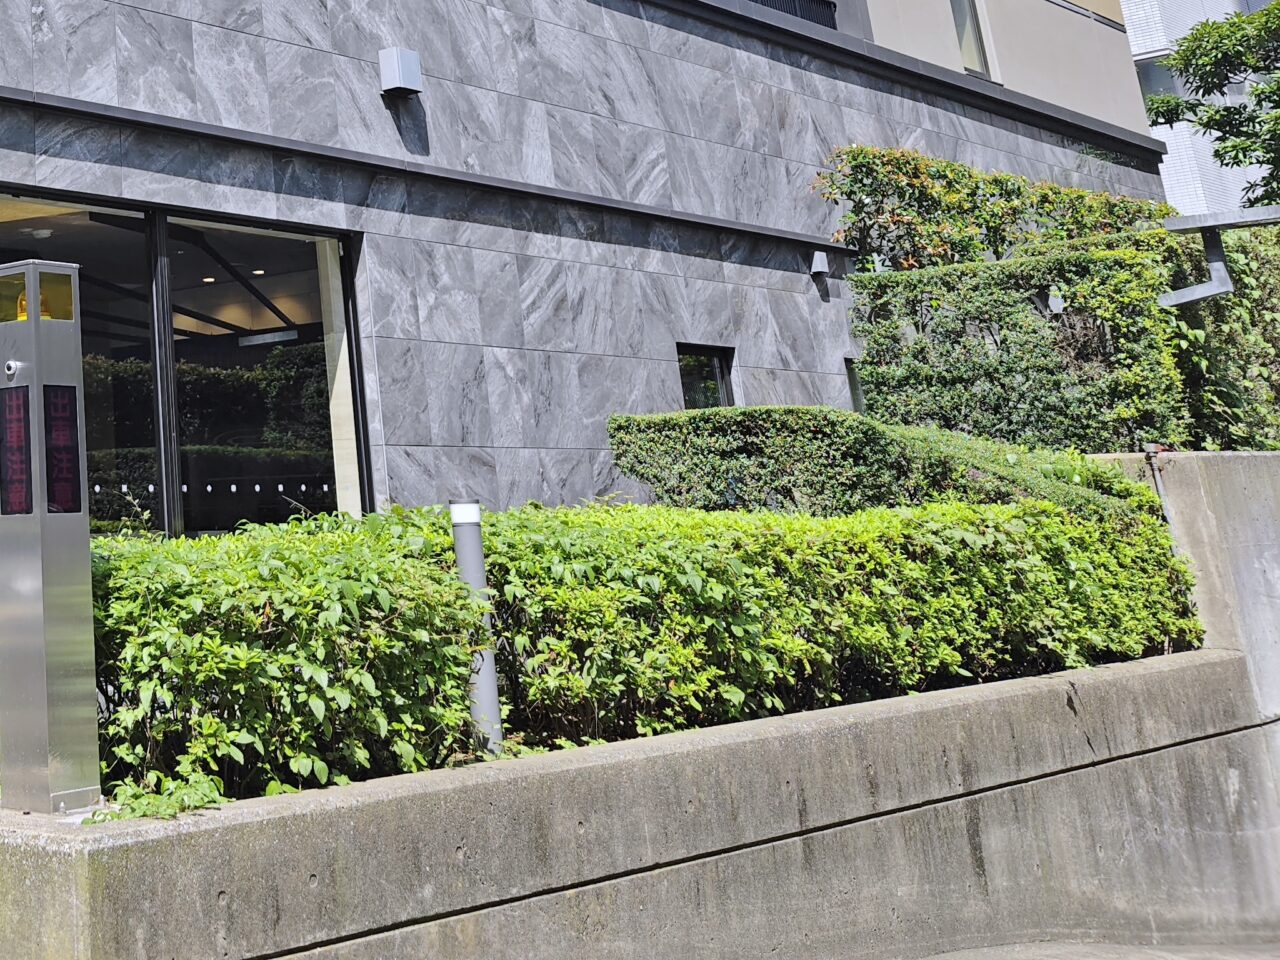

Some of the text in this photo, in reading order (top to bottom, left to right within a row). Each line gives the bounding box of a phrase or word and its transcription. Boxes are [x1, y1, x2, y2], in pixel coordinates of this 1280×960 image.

[5, 390, 27, 513] 出車注意
[51, 391, 75, 510] 出車注意
